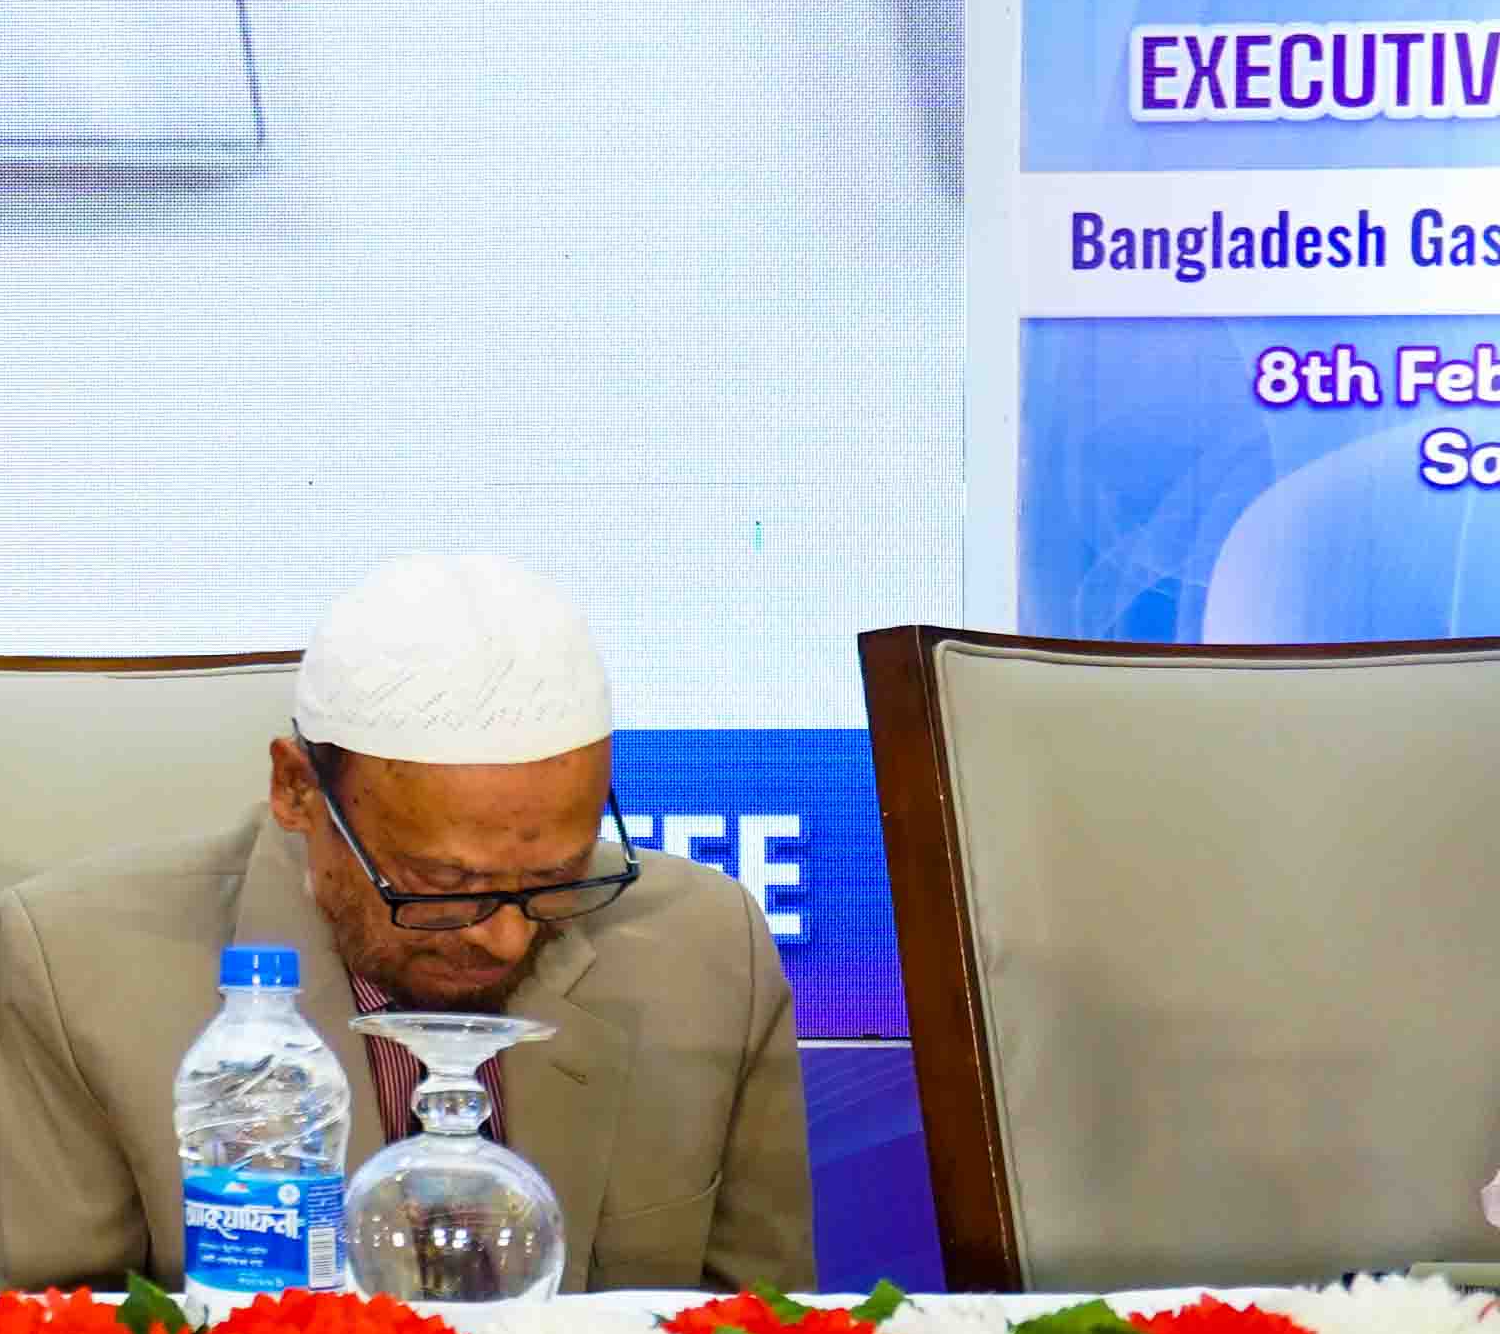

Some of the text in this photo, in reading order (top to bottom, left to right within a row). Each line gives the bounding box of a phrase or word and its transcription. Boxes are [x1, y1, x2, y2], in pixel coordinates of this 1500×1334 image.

[1141, 32, 1500, 111] EXECUTIV
[1070, 207, 1500, 284] Bangladesh Gas
[1255, 343, 1382, 410] 8th
